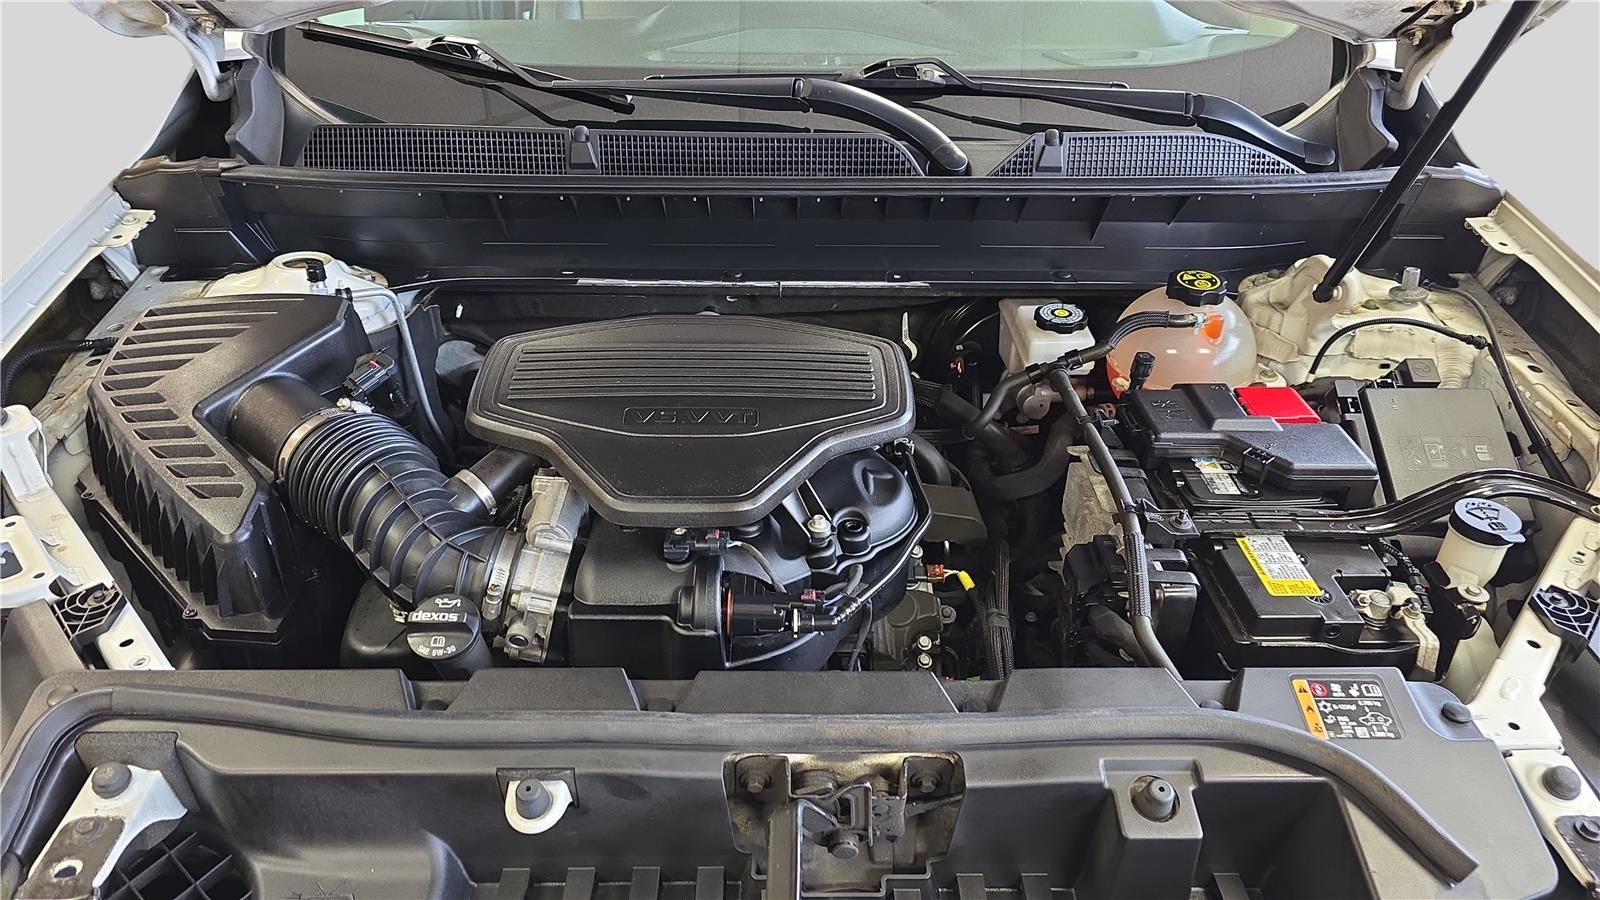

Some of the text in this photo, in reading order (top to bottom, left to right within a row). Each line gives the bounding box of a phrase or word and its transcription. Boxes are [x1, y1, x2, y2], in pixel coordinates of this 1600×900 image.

[412, 610, 459, 622] dexos
[417, 645, 456, 656] SAE 5W-30
